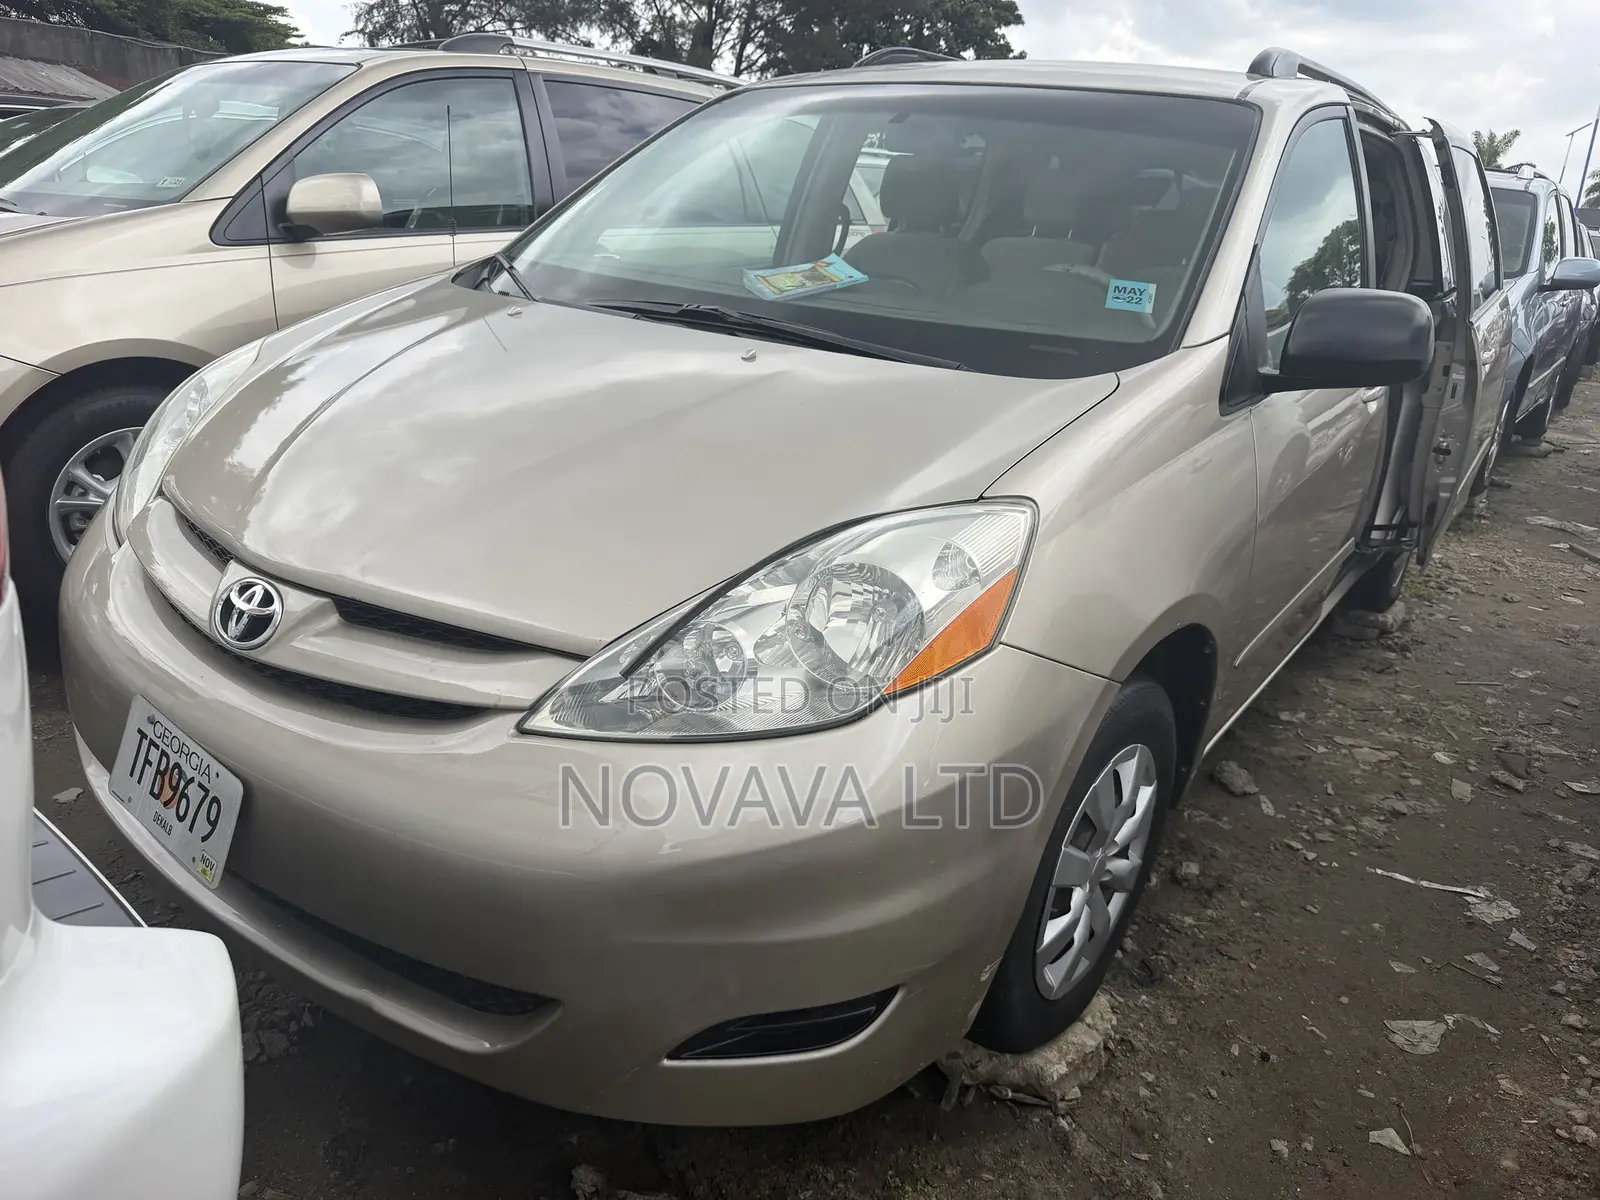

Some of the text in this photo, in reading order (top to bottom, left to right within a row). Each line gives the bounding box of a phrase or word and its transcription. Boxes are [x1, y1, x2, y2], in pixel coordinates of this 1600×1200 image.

[1113, 285, 1146, 296] MAY
[1126, 296, 1143, 305] 22
[152, 720, 212, 784] GEORGIA
[129, 727, 222, 843] TFB9679
[152, 811, 174, 836] DEKALB
[200, 853, 215, 871] NOV
